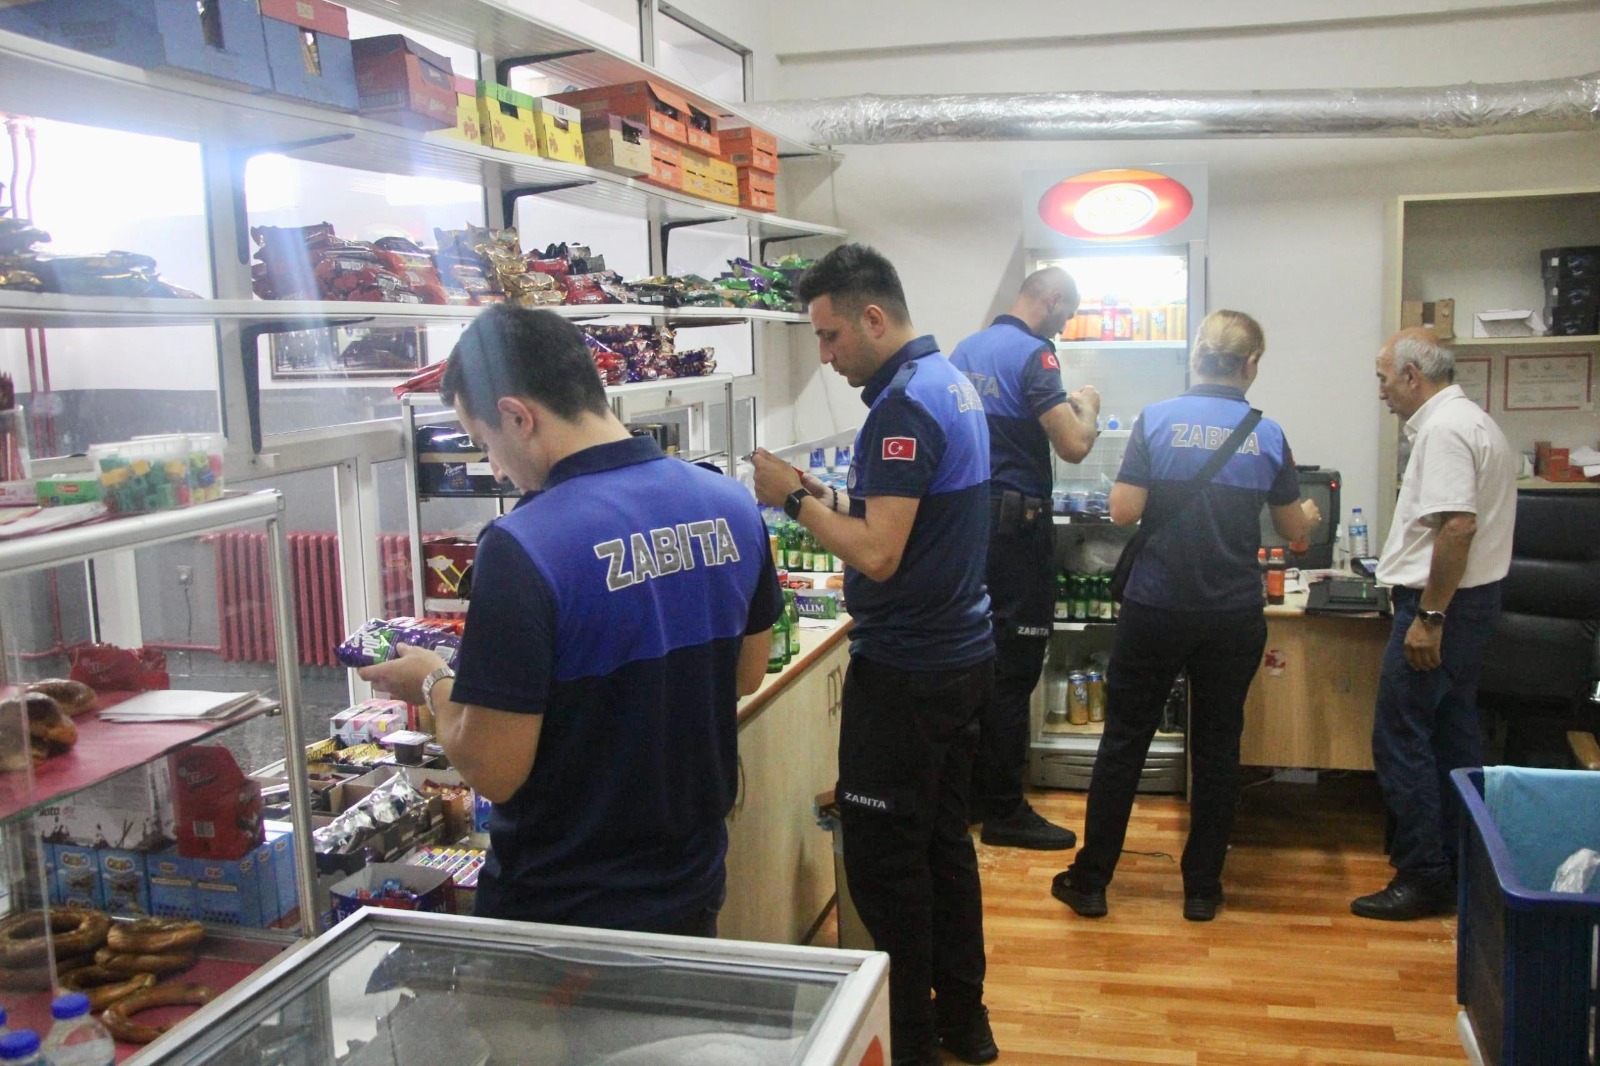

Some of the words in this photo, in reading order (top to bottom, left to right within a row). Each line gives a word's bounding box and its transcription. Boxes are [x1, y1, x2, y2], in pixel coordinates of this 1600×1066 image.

[1171, 423, 1260, 455] ZABIA
[593, 518, 741, 592] ZABITA
[797, 604, 825, 613] ALIM
[1017, 626, 1049, 636] ZABITA
[844, 791, 886, 809] ZABITA
